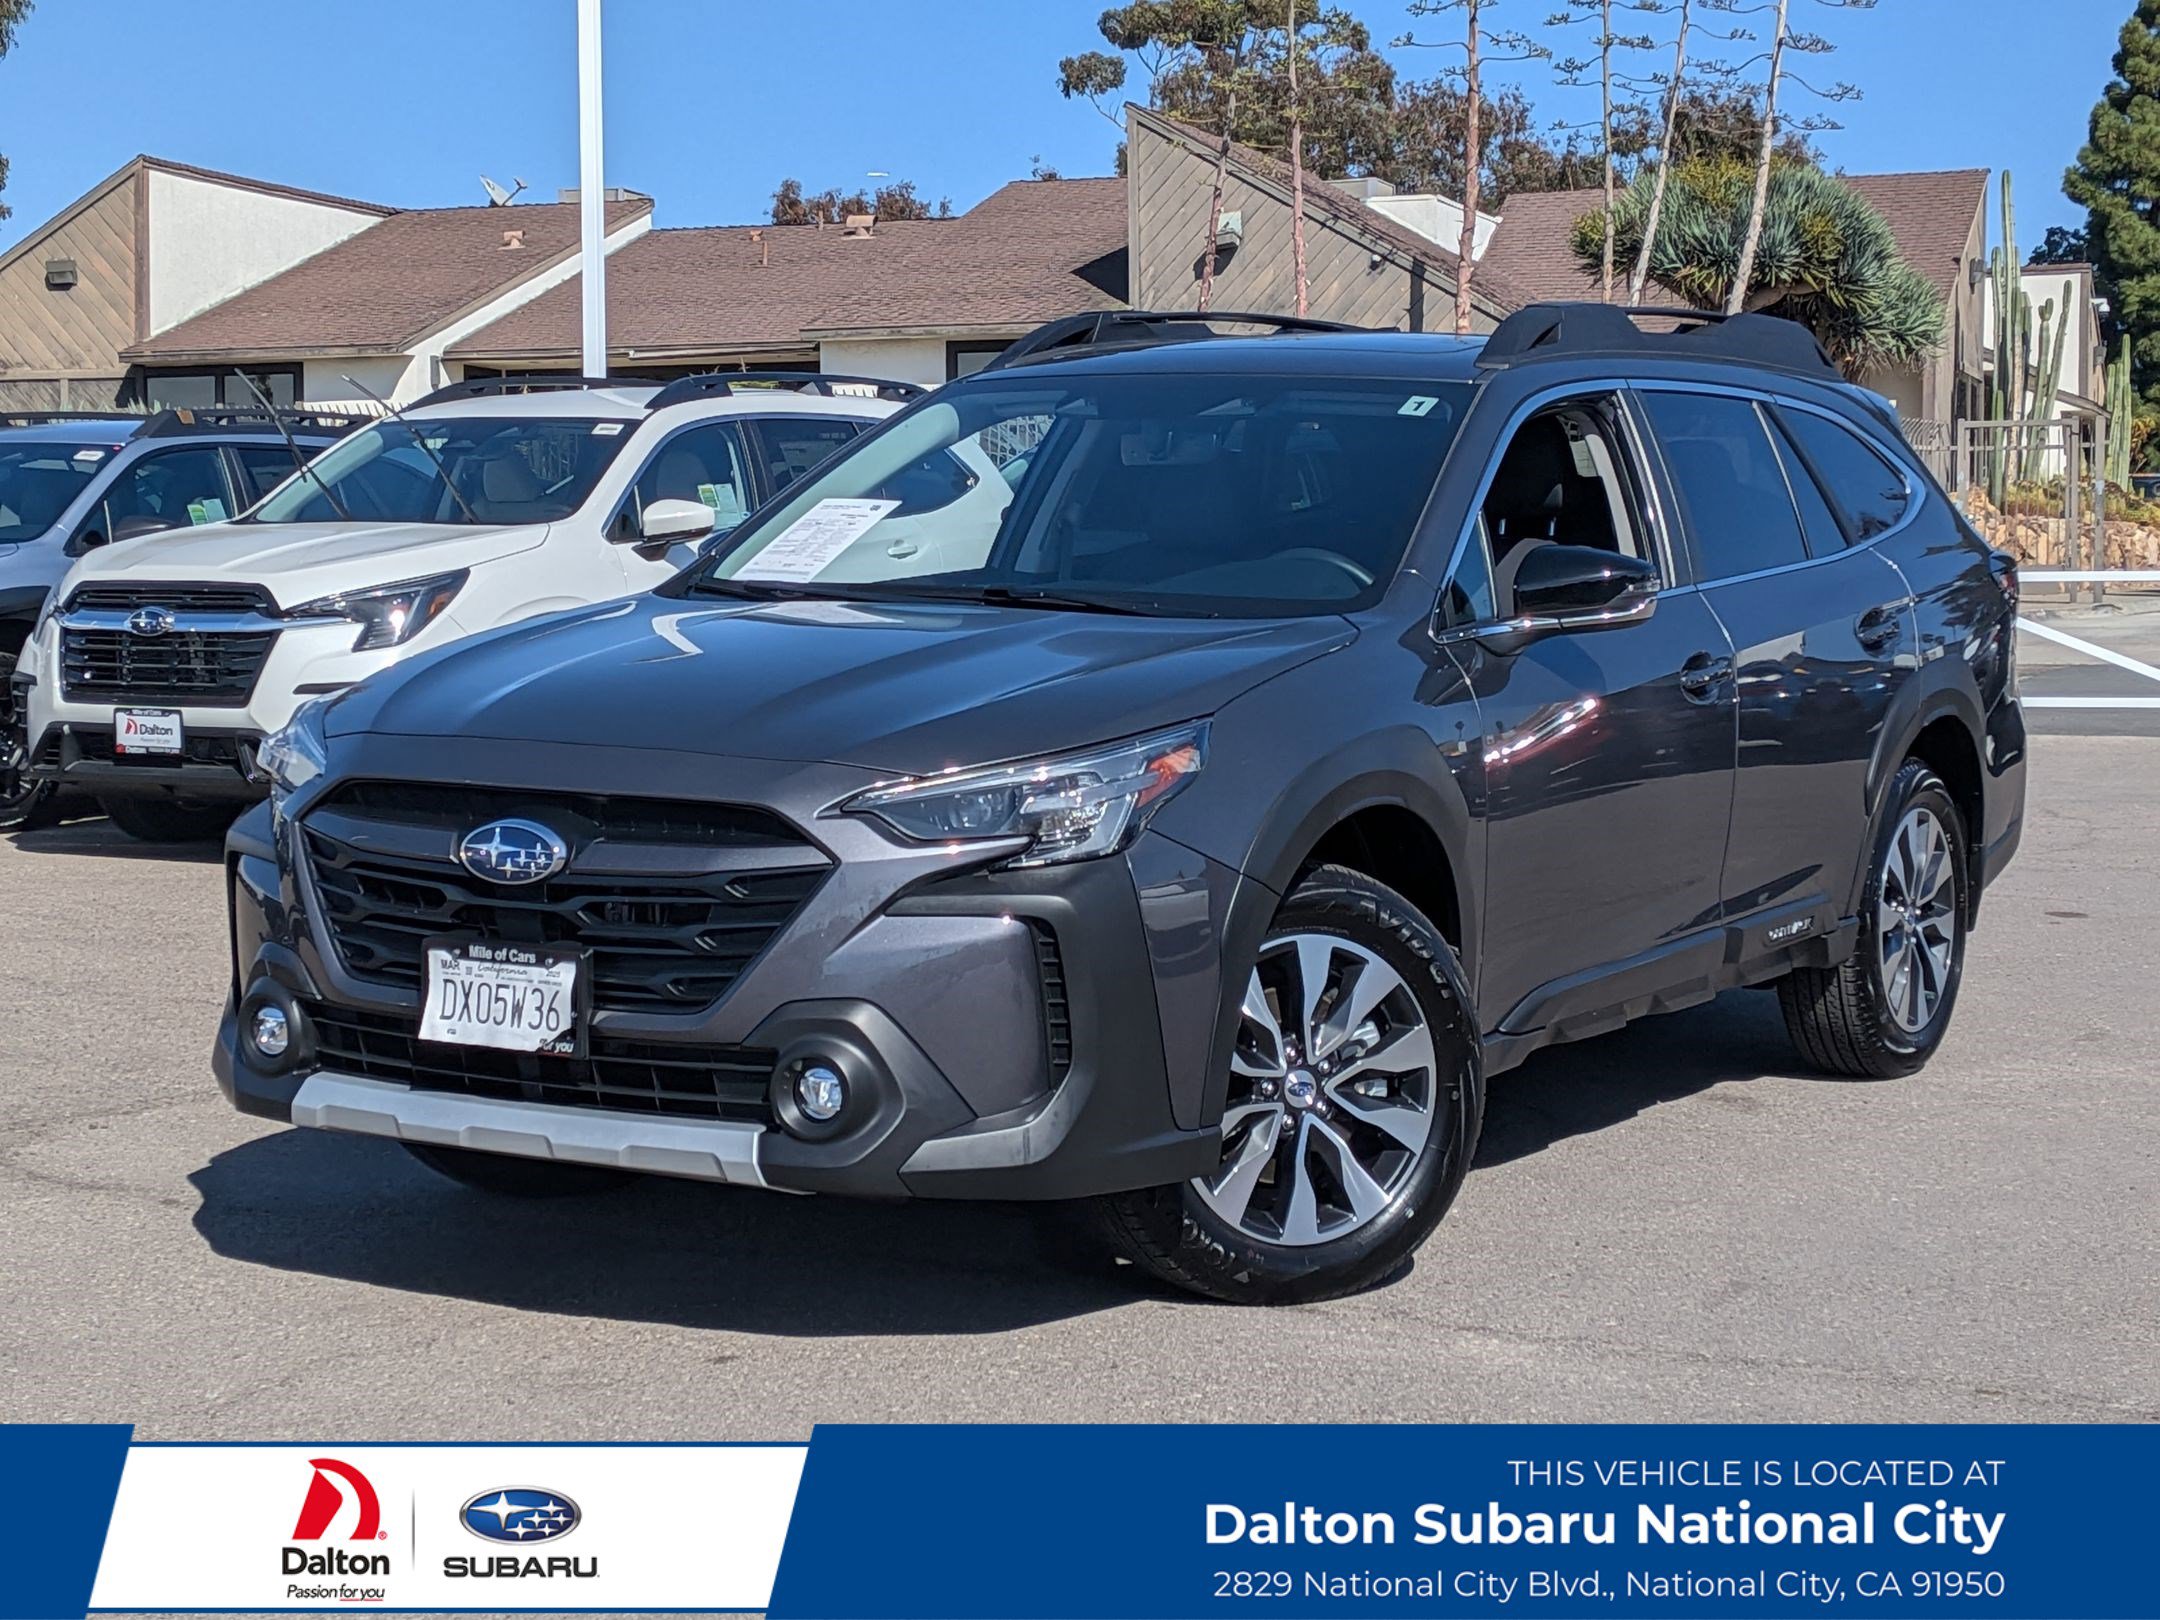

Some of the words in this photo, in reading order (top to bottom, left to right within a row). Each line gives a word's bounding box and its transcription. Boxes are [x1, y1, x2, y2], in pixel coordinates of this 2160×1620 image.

[139, 723, 173, 736] Dalton
[468, 944, 492, 959] Mile
[494, 947, 508, 961] of
[508, 948, 537, 964] Cars
[477, 961, 528, 980] California
[439, 978, 561, 1032] DX05W36
